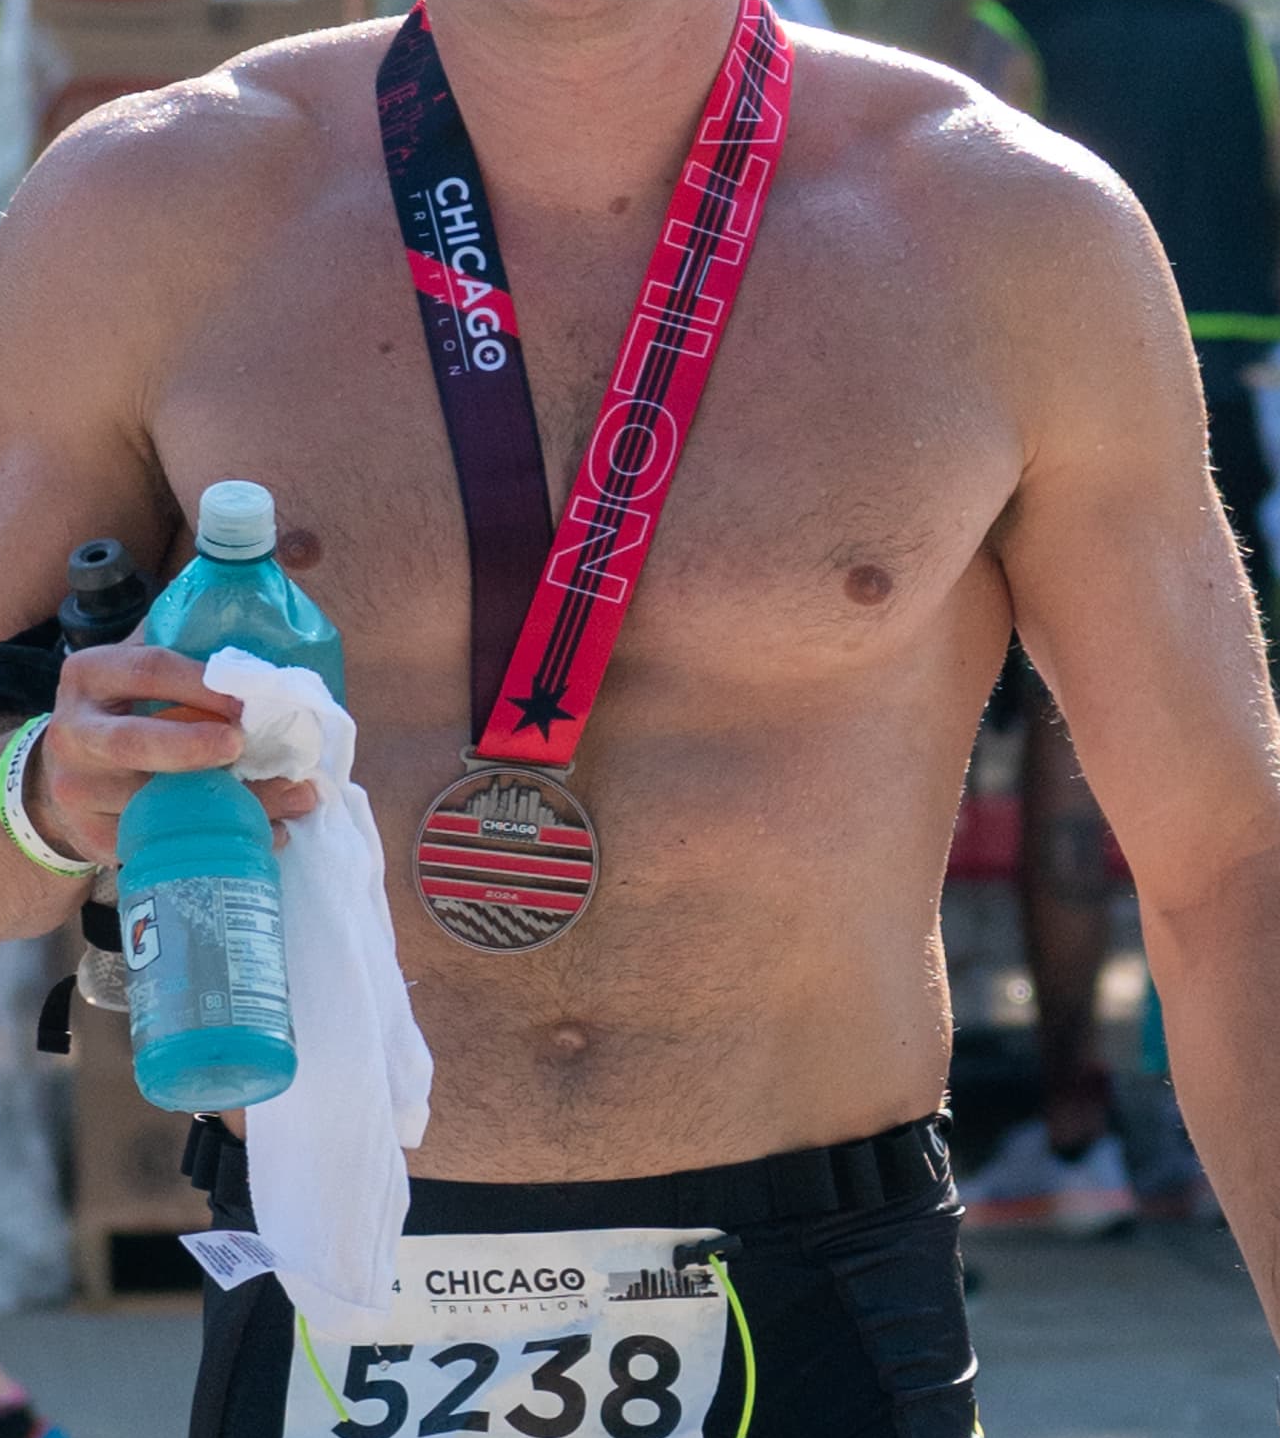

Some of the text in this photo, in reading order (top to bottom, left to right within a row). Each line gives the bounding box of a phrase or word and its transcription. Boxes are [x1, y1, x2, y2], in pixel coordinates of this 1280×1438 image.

[407, 191, 462, 377] TRIATHLON
[435, 177, 507, 372] CHICAGO
[482, 819, 537, 835] CHICAGO
[485, 890, 518, 900] 2024
[124, 897, 161, 971] G
[205, 994, 222, 1009] 80
[425, 1268, 585, 1295] CHICAGO
[431, 1300, 589, 1314] TRIATHLON
